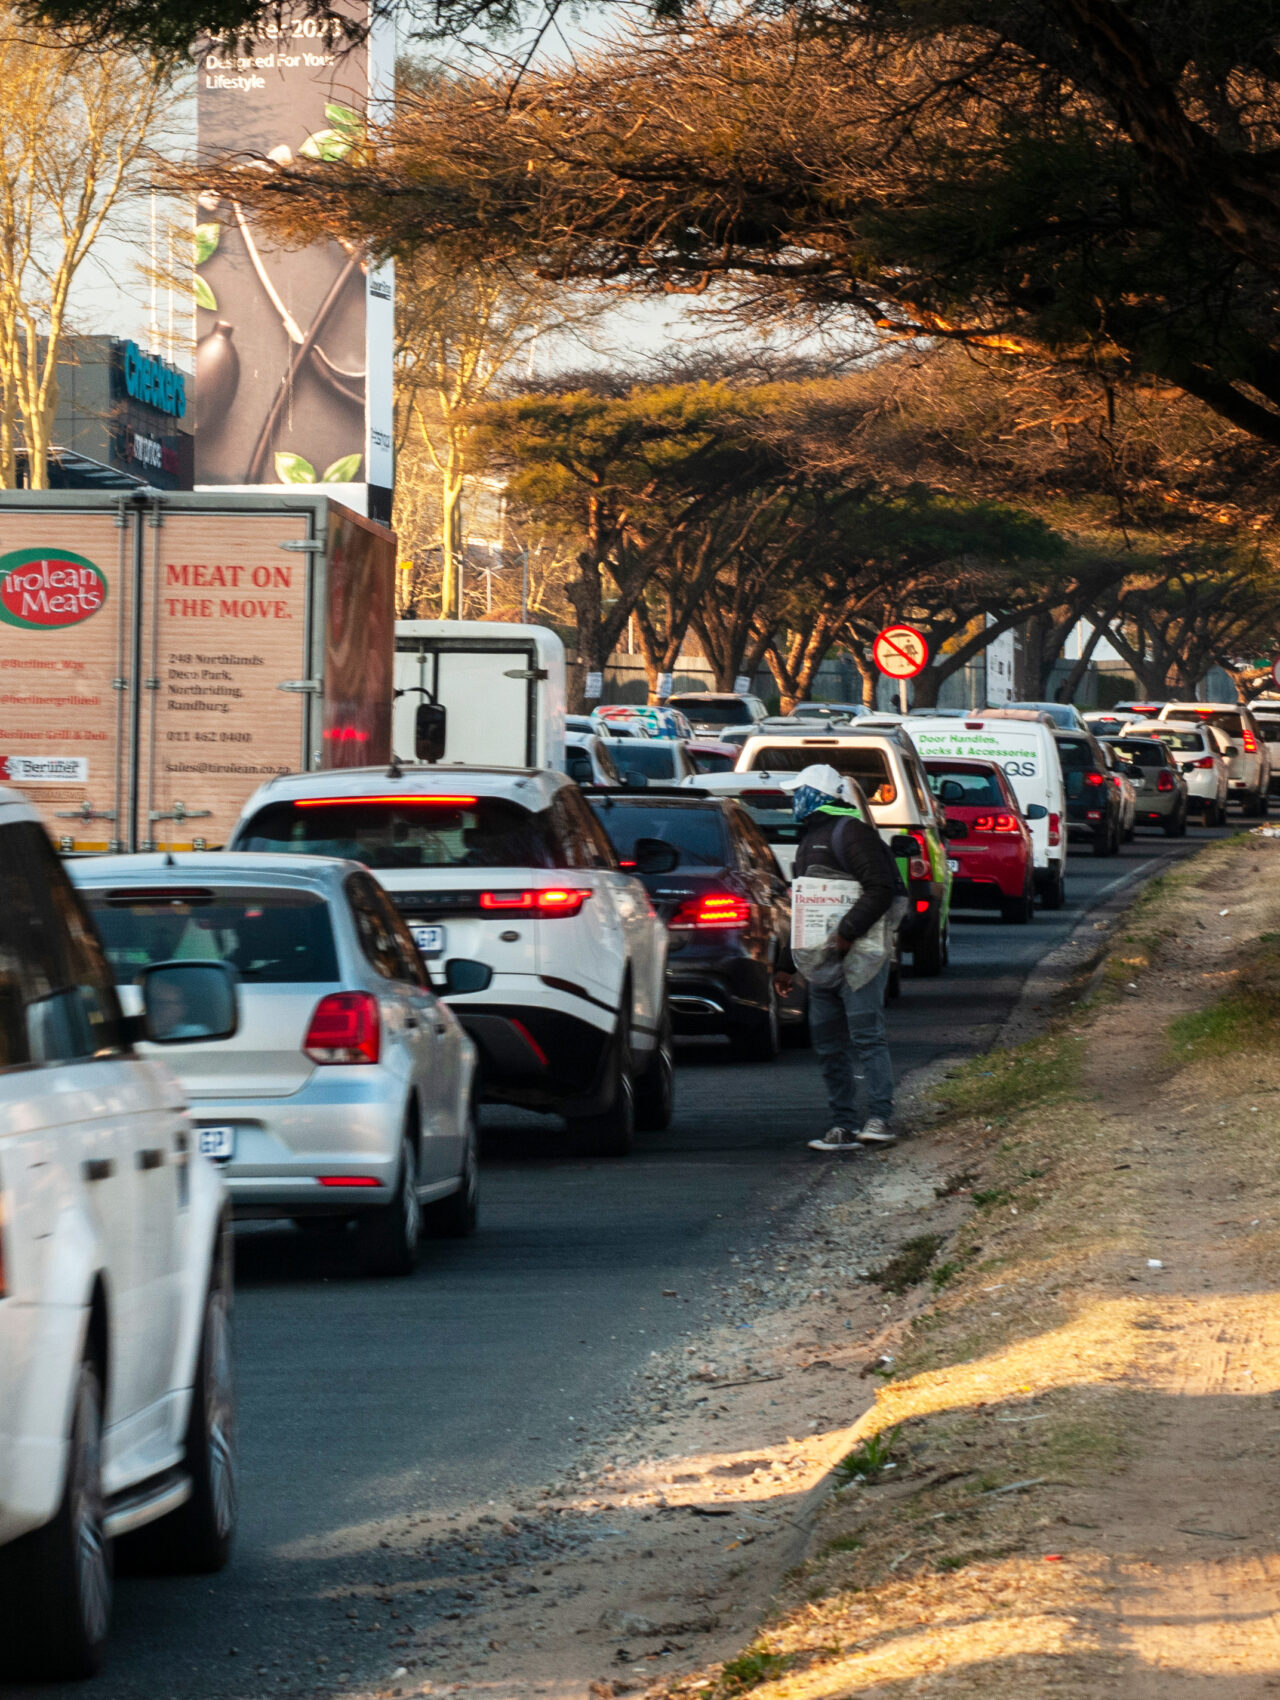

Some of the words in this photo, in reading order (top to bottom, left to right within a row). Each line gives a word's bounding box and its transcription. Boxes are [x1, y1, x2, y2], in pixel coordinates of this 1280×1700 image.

[277, 53, 301, 68] For
[205, 73, 266, 92] Lifestyle
[164, 563, 246, 588] MEAT
[251, 564, 293, 589] ON
[21, 586, 102, 617] Meats
[163, 597, 215, 618] THE
[219, 599, 293, 620] MOVE.
[168, 653, 193, 664] 248
[195, 654, 265, 666] Northlands
[168, 668, 199, 680] Deco
[45, 729, 71, 741] Grill
[73, 730, 83, 741] &
[166, 730, 191, 742] 011
[919, 734, 946, 744] Door
[949, 734, 1001, 745] Handles,
[919, 747, 953, 756] Locks
[955, 746, 964, 756] &
[967, 746, 1038, 759] Accessories
[20, 759, 81, 774] Berliner
